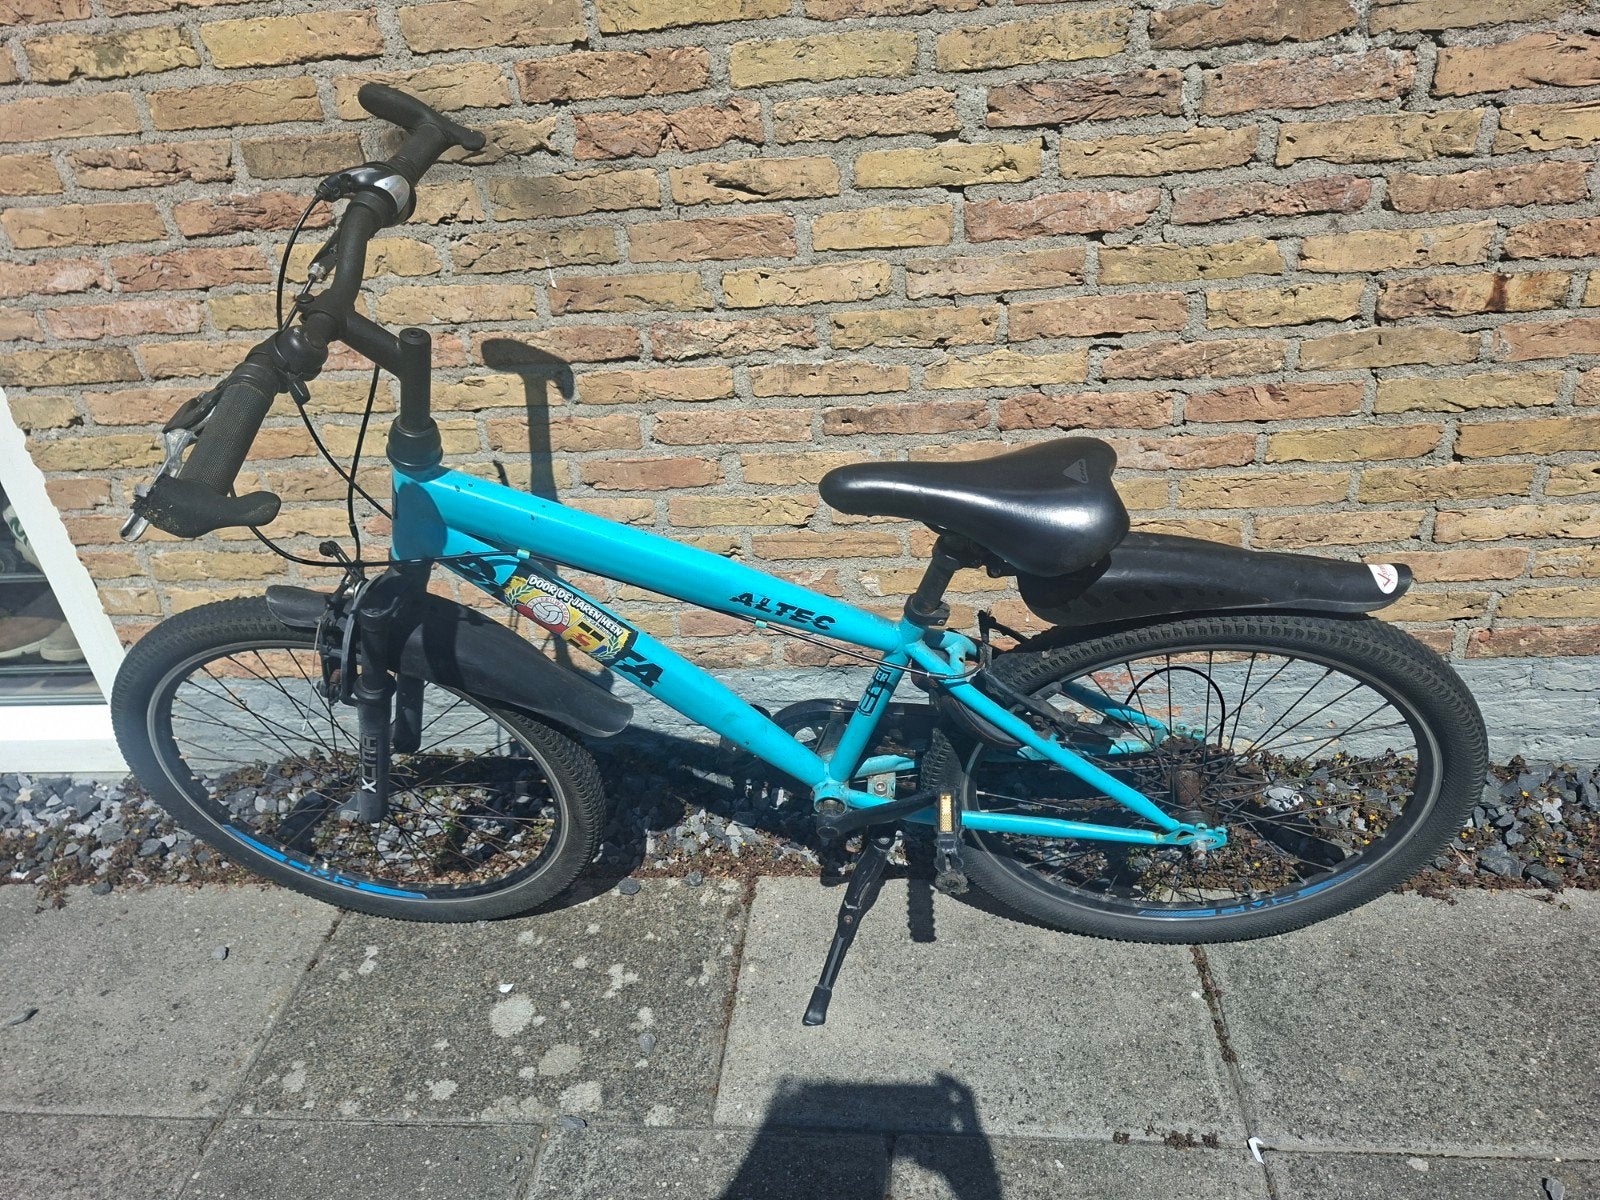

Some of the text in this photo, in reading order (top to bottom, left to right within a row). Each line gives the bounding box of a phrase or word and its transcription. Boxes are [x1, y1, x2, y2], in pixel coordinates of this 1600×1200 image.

[526, 574, 624, 638] DOOR DE JAREN HEEN
[729, 593, 835, 630] ALTEC
